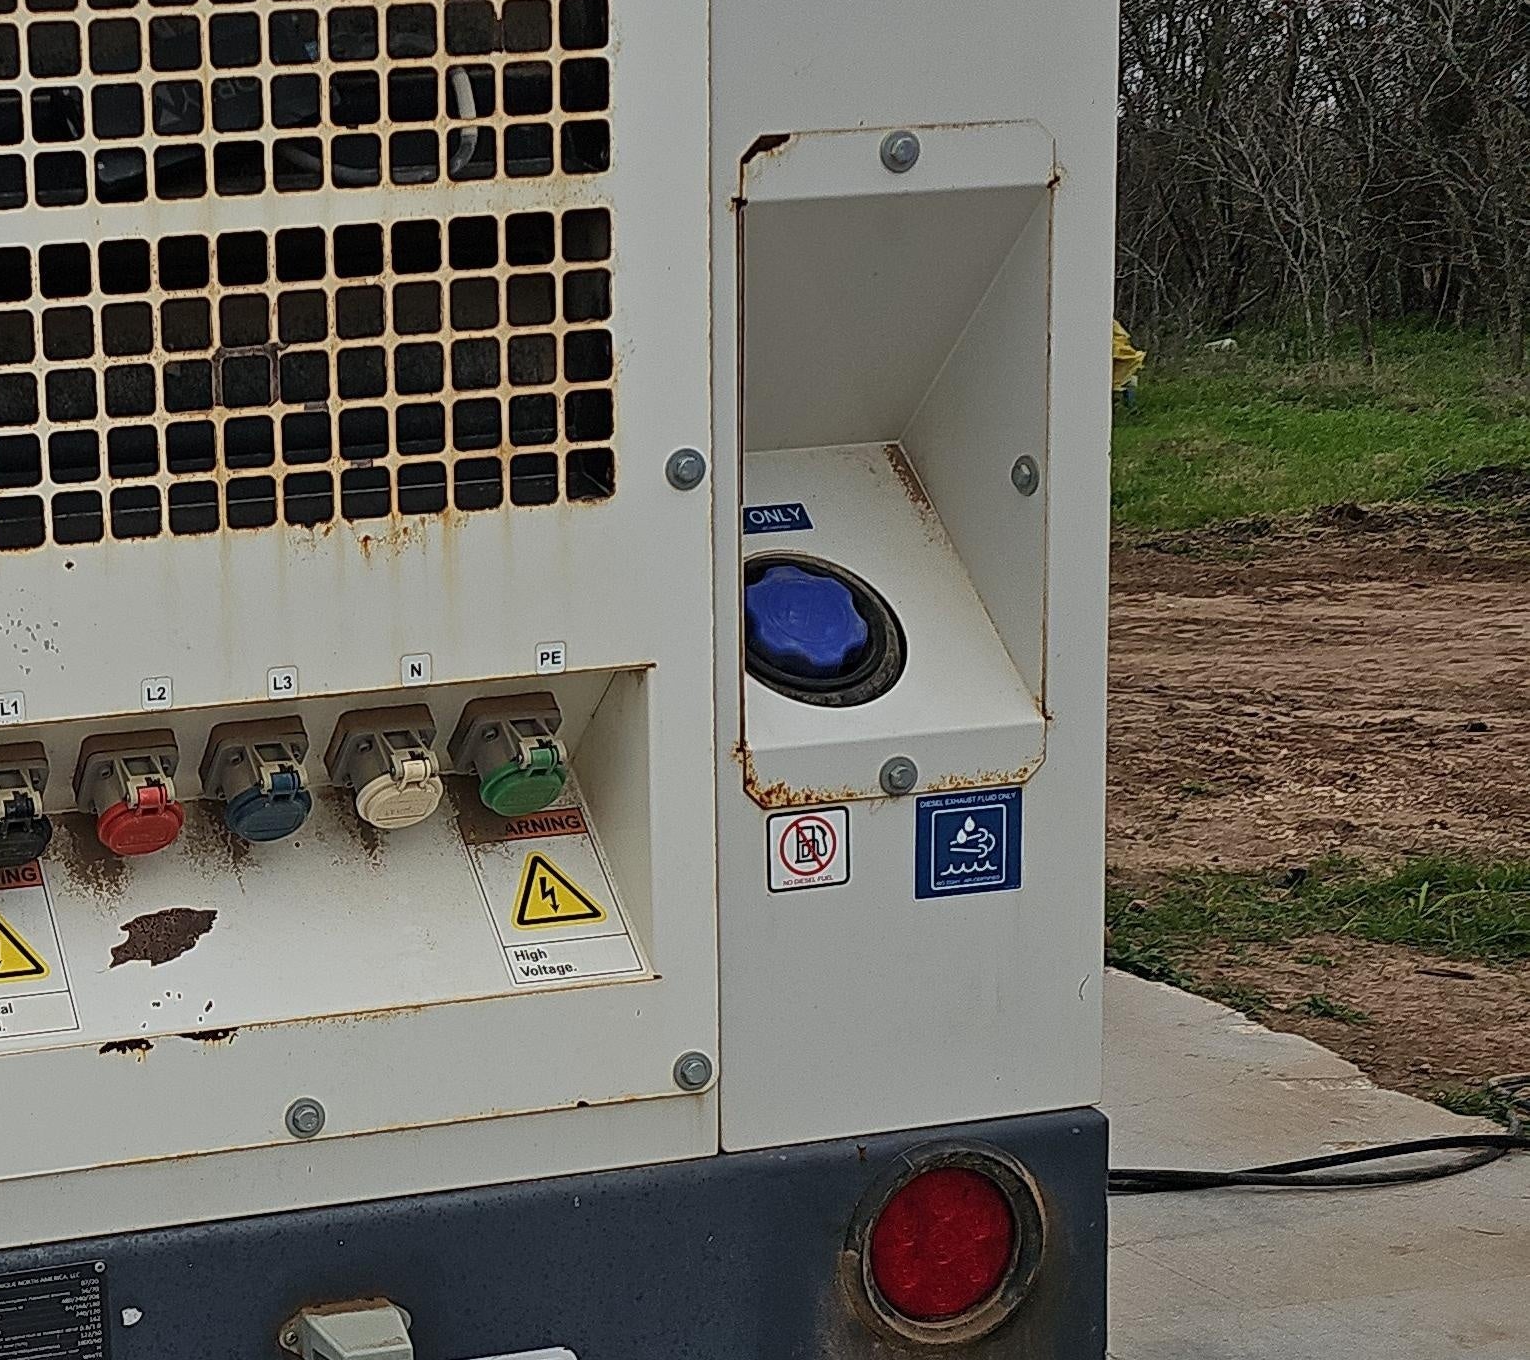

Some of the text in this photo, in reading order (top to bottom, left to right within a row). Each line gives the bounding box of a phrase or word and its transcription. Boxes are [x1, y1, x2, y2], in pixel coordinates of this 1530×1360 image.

[749, 507, 800, 525] ONLY
[540, 651, 562, 666] PE
[410, 663, 422, 678] N
[273, 675, 293, 691] L3
[147, 686, 167, 702] L2
[0, 700, 19, 716] L1
[919, 791, 1017, 809] DIESEL EXHAUST FLUID ONLY
[505, 814, 581, 835] ARNING
[783, 874, 834, 887] NO DIESEL FUEL
[514, 948, 548, 963] High
[519, 963, 578, 978] Voltage.
